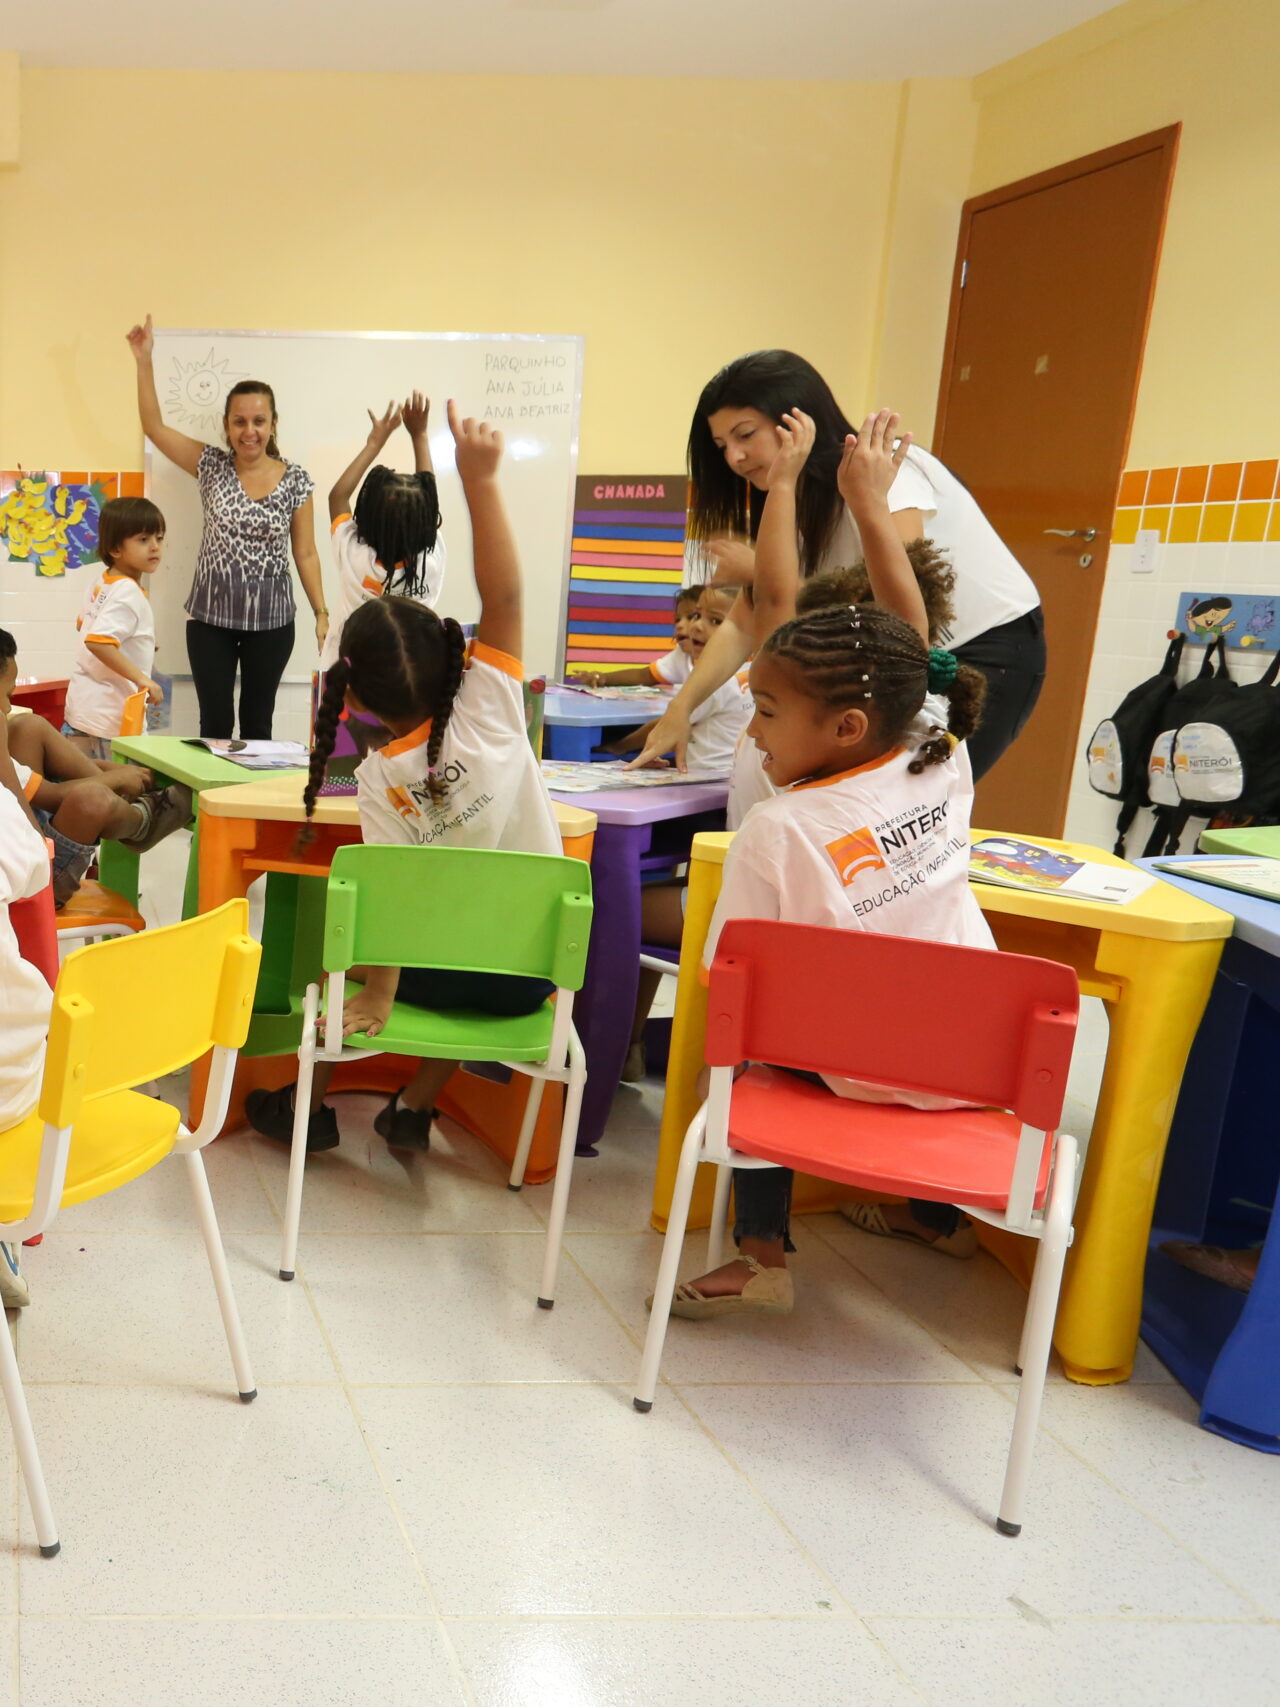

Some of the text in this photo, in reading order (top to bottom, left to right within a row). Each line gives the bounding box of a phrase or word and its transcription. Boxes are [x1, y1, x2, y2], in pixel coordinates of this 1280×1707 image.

[485, 353, 566, 373] PARQUINHO
[486, 376, 564, 397] ANA JÚLIA
[484, 403, 570, 419] ANA BEATRIZ
[593, 484, 665, 499] CHAMADA
[875, 804, 928, 833] PREFEITURA
[880, 800, 948, 854] NITER
[853, 870, 926, 917] EDUCAÇÃO
